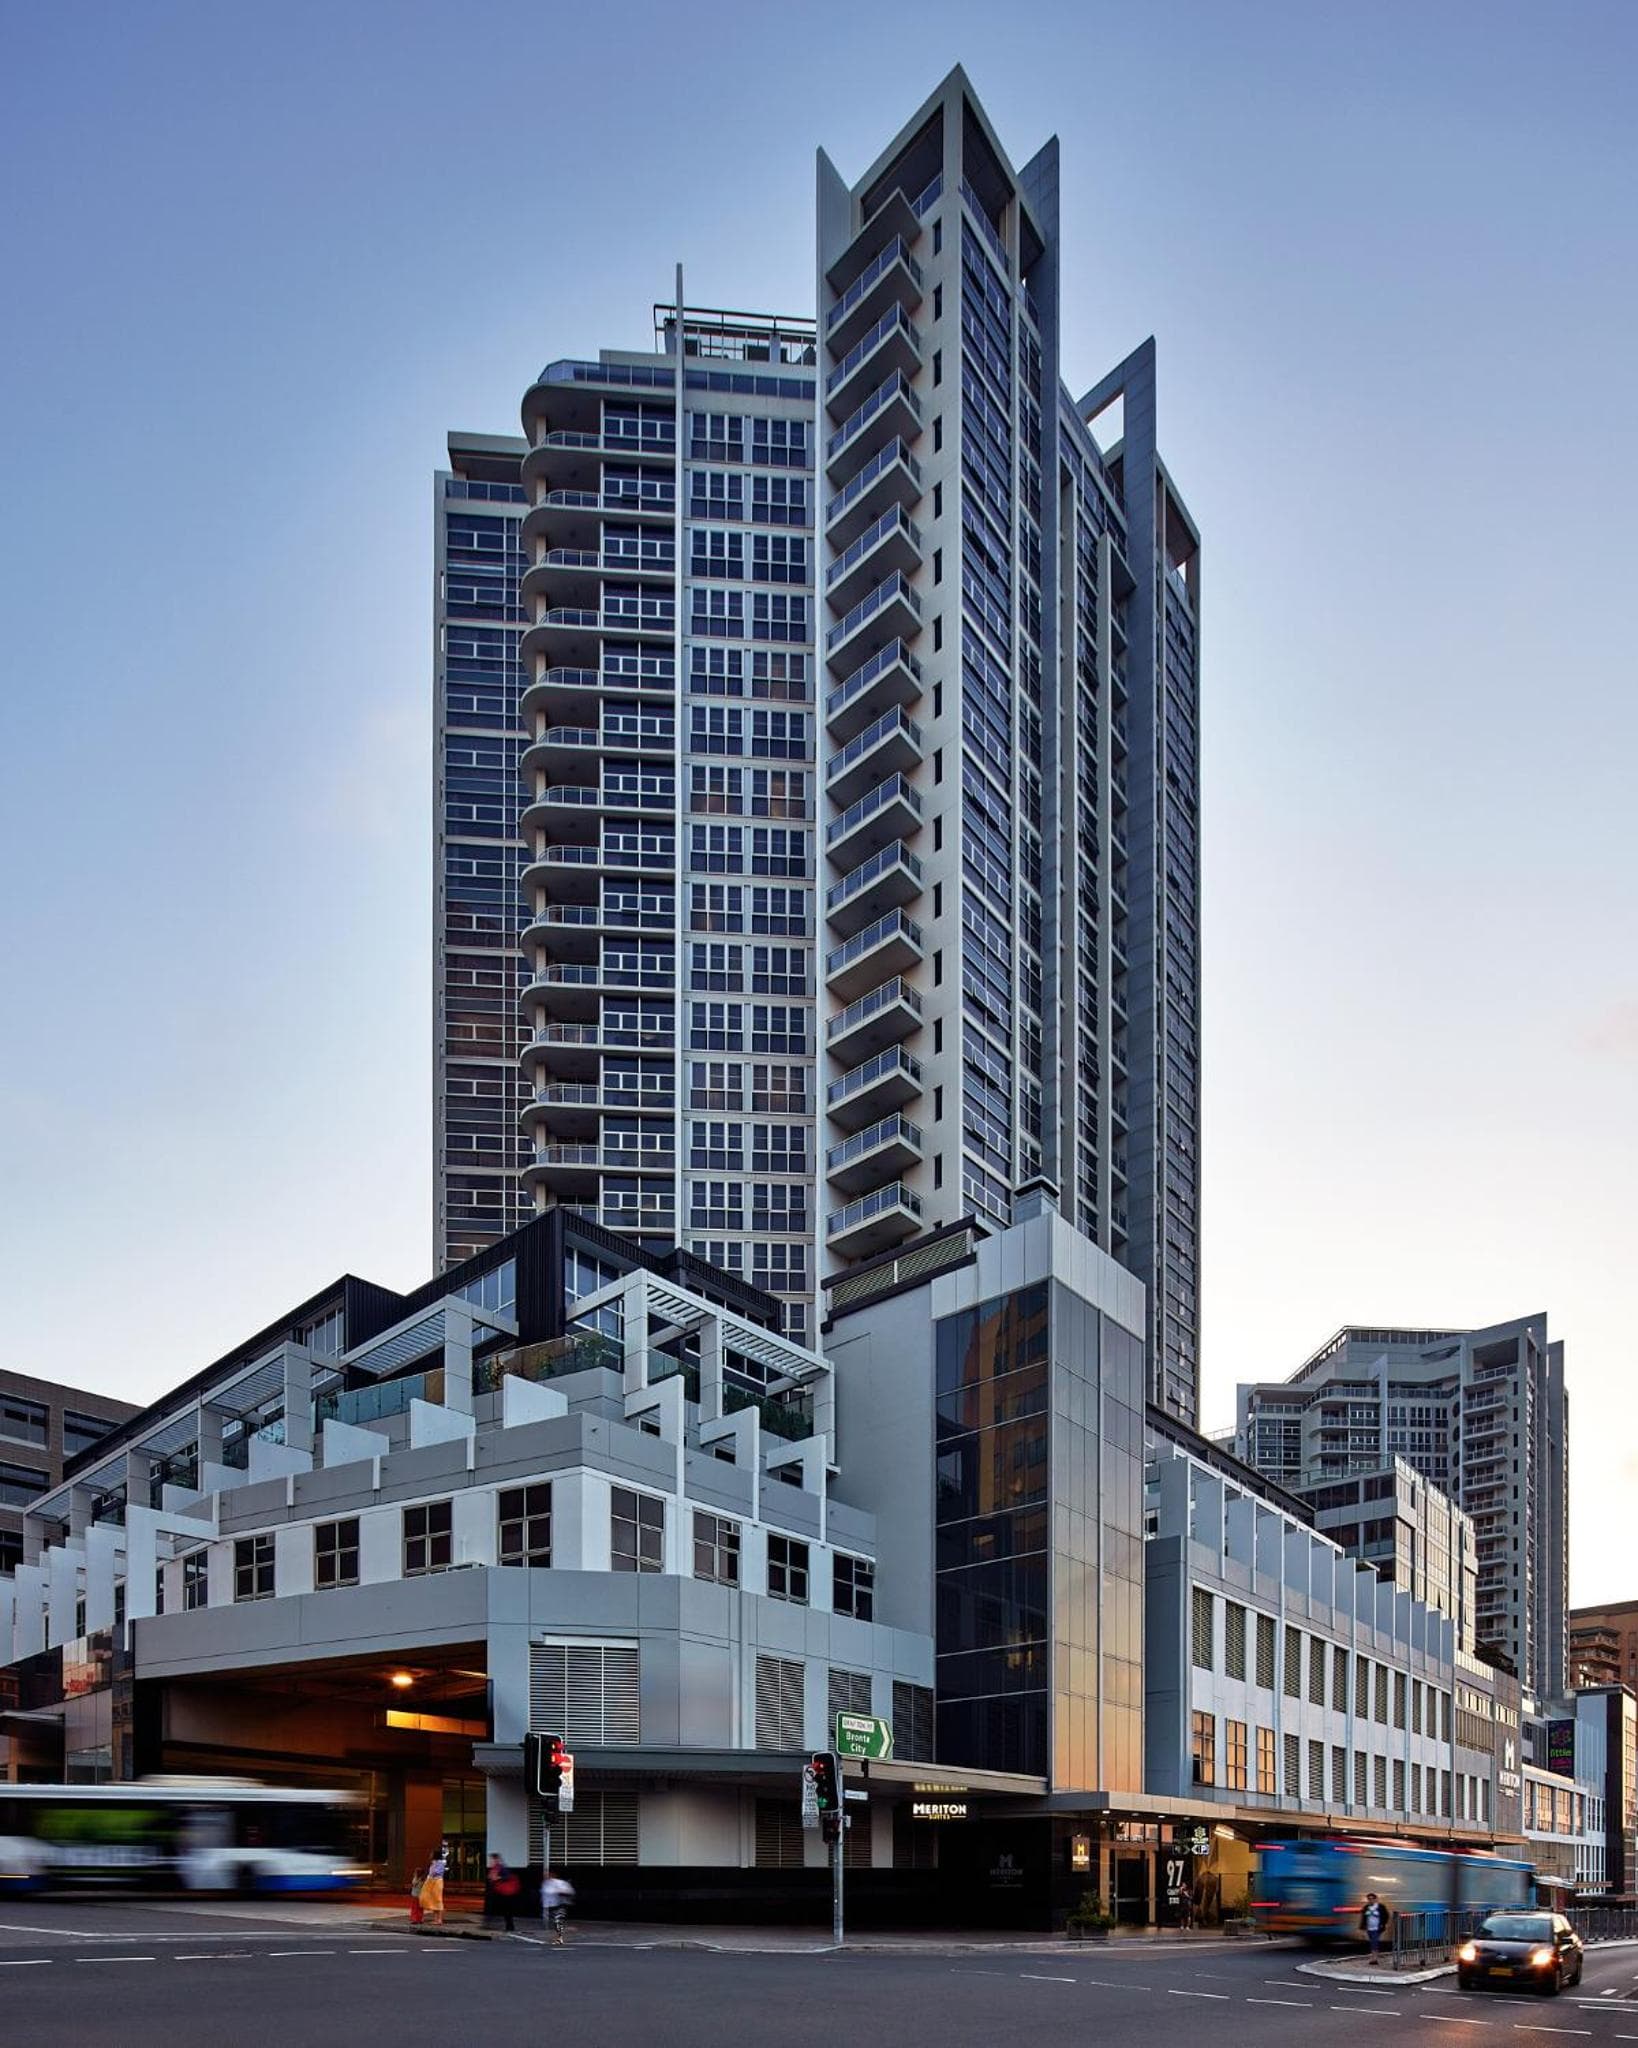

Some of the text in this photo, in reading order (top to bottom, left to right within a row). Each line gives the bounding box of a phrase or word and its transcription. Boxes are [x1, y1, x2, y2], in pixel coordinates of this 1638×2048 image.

[846, 1731, 870, 1743] Bronte
[851, 1743, 867, 1755] City
[913, 1803, 967, 1815] MERITON
[1167, 1860, 1184, 1887] 97
